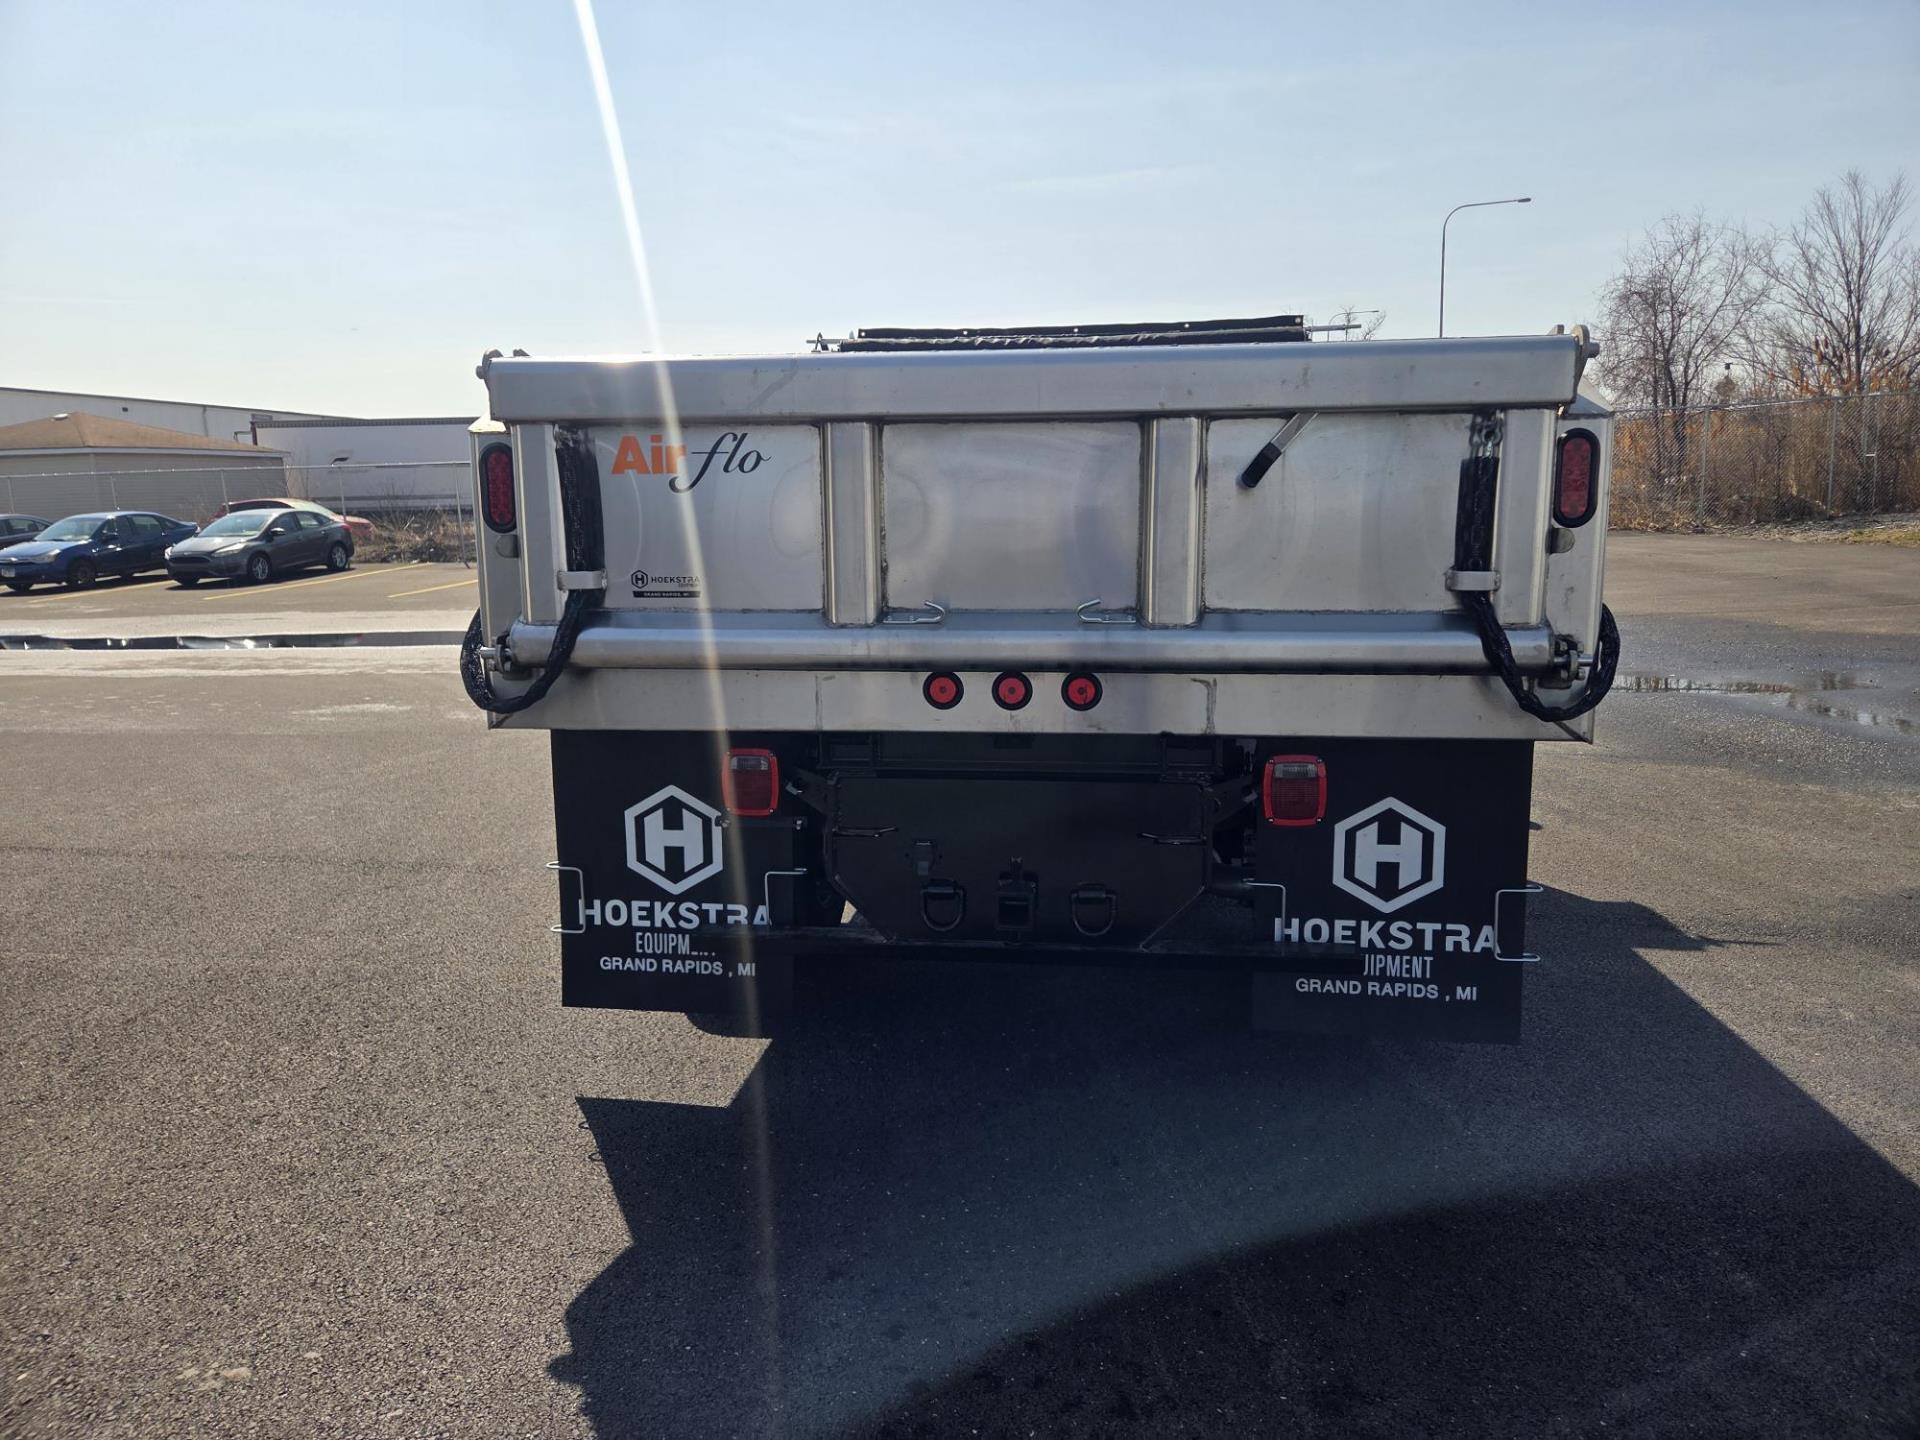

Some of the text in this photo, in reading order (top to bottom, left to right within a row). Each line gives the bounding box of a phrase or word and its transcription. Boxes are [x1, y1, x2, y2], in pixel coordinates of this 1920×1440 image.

[651, 576, 700, 584] HOEKSTRA
[644, 808, 704, 872] H
[1354, 821, 1423, 890] H
[578, 899, 771, 929] HOEKSTRA
[636, 932, 715, 956] EQUIPM
[1274, 917, 1499, 953] HOEKSTRA
[600, 956, 657, 973] GRAND
[738, 963, 756, 977] MI
[1295, 978, 1362, 995] GRAND
[1456, 986, 1477, 1001] MI
